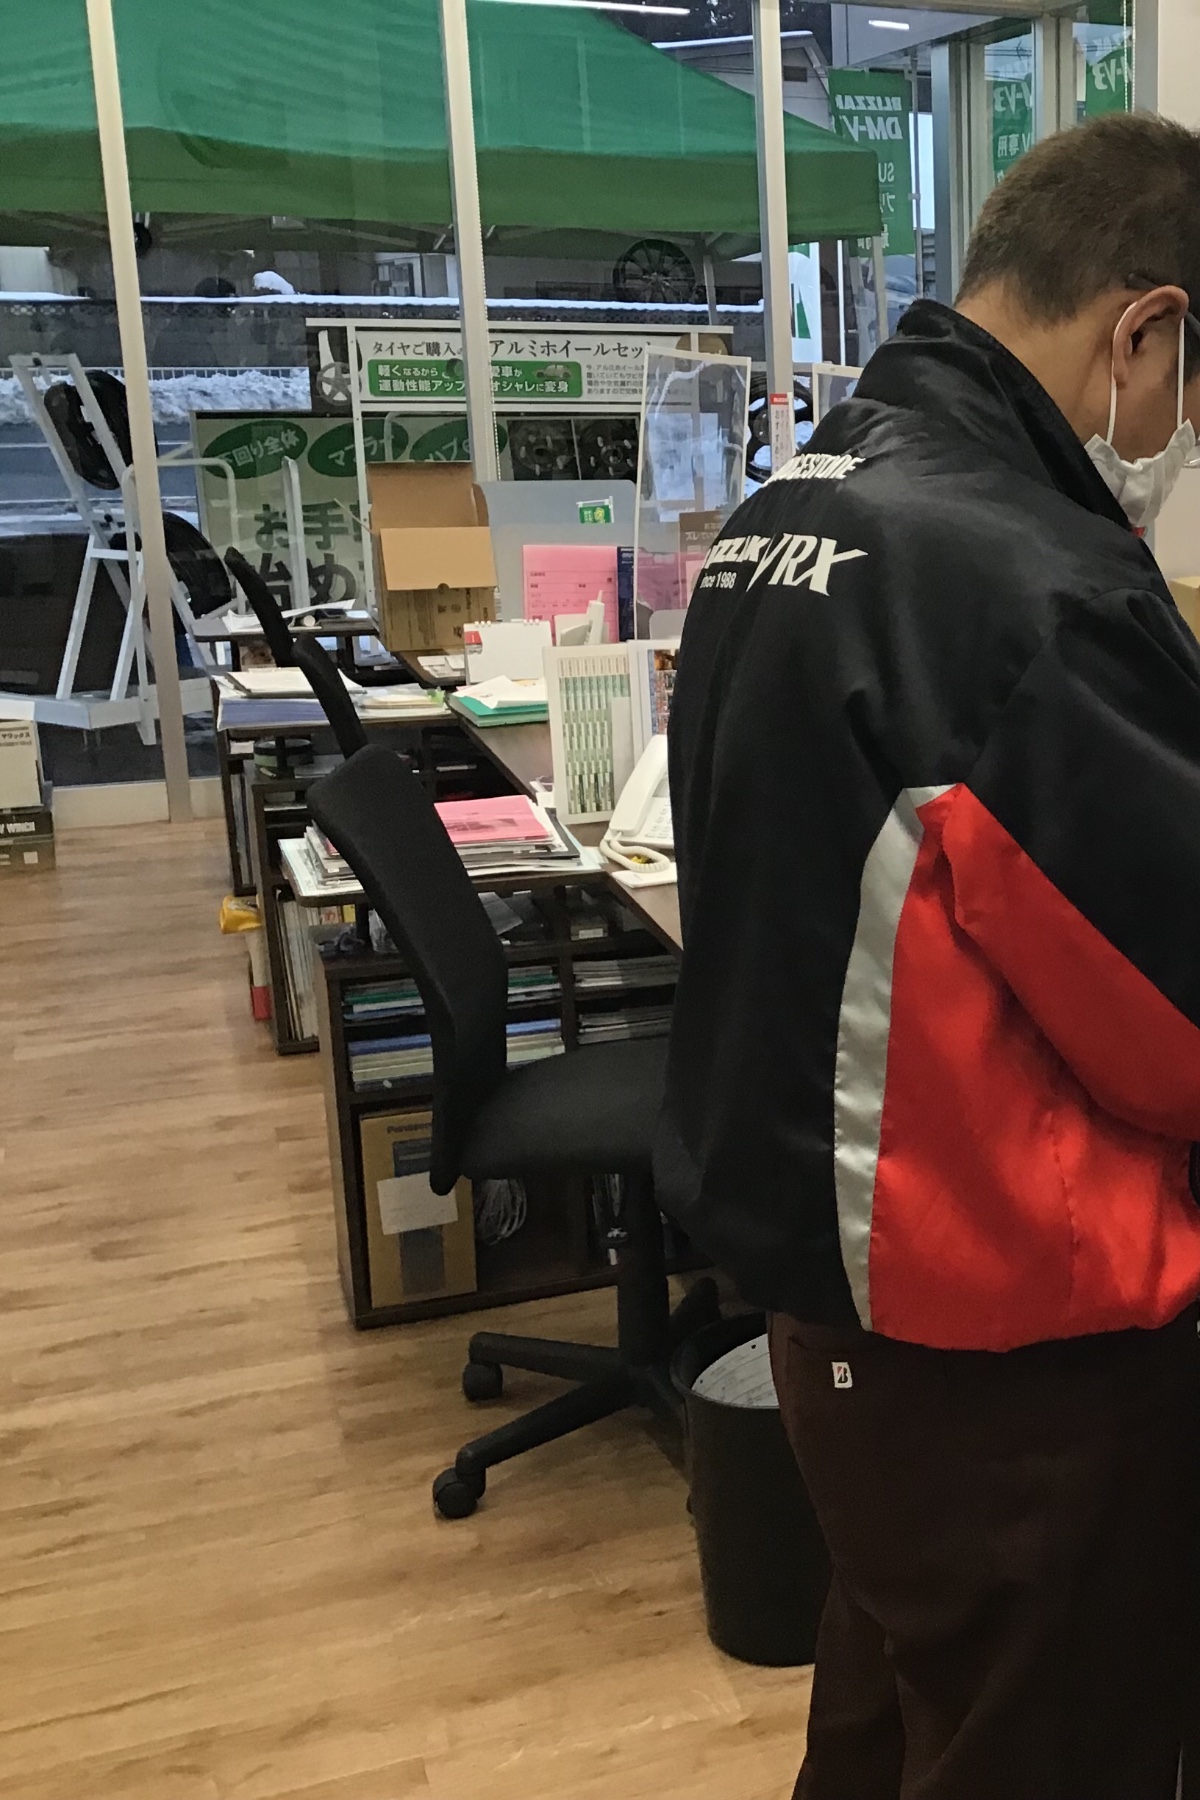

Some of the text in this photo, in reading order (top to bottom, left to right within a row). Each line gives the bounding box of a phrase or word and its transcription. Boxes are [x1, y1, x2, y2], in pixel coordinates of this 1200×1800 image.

[489, 340, 649, 358] アルミホイールセッ
[378, 364, 439, 378] 軽くなるから
[746, 532, 868, 597] VRX
[700, 571, 737, 589] ince 1988
